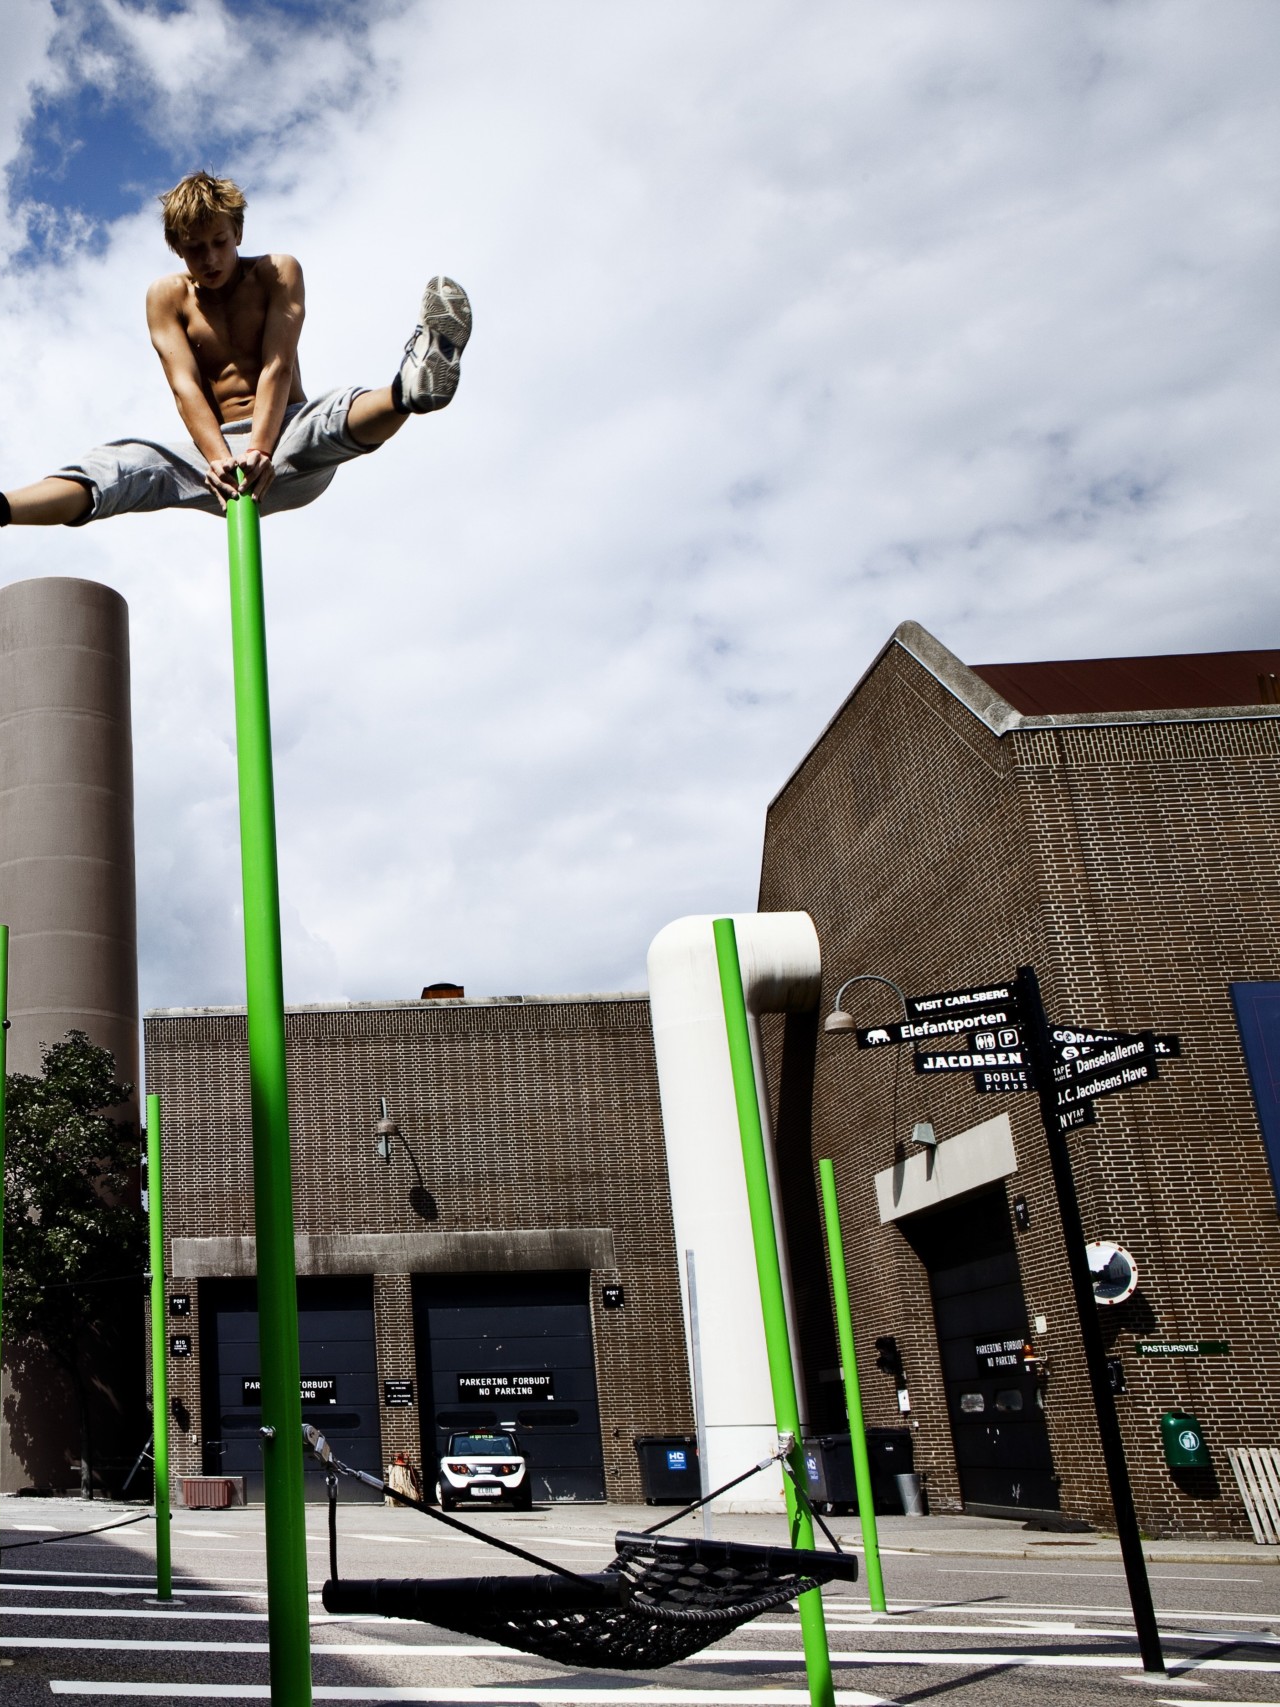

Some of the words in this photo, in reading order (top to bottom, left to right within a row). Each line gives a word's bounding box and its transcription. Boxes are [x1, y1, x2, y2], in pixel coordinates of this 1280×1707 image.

[914, 999, 943, 1012] VISIT
[944, 989, 1009, 1007] CARLSBERG
[900, 1012, 1007, 1039] Elefantporten
[1003, 1032, 1013, 1045] P
[923, 1052, 1023, 1069] JACOBSEN
[1076, 1041, 1145, 1074] Dansehallerne
[984, 1072, 1027, 1083] BOBLE
[985, 1083, 1028, 1091] PLADS
[1057, 1088, 1075, 1105] J.C.
[1075, 1074, 1122, 1100] Jacobsens
[1122, 1066, 1148, 1083] Have
[975, 1342, 1002, 1355] PARKERING
[1003, 1339, 1025, 1351] FORBUDT
[1141, 1344, 1199, 1353] PASTEURSVEJ
[987, 1357, 994, 1367] NO
[995, 1354, 1018, 1366] PARKING
[299, 1380, 333, 1389] ORBUDT
[459, 1377, 508, 1386] PARKERING
[512, 1376, 551, 1385] FORBUDT
[479, 1387, 490, 1396] NO
[494, 1386, 533, 1396] PARKING
